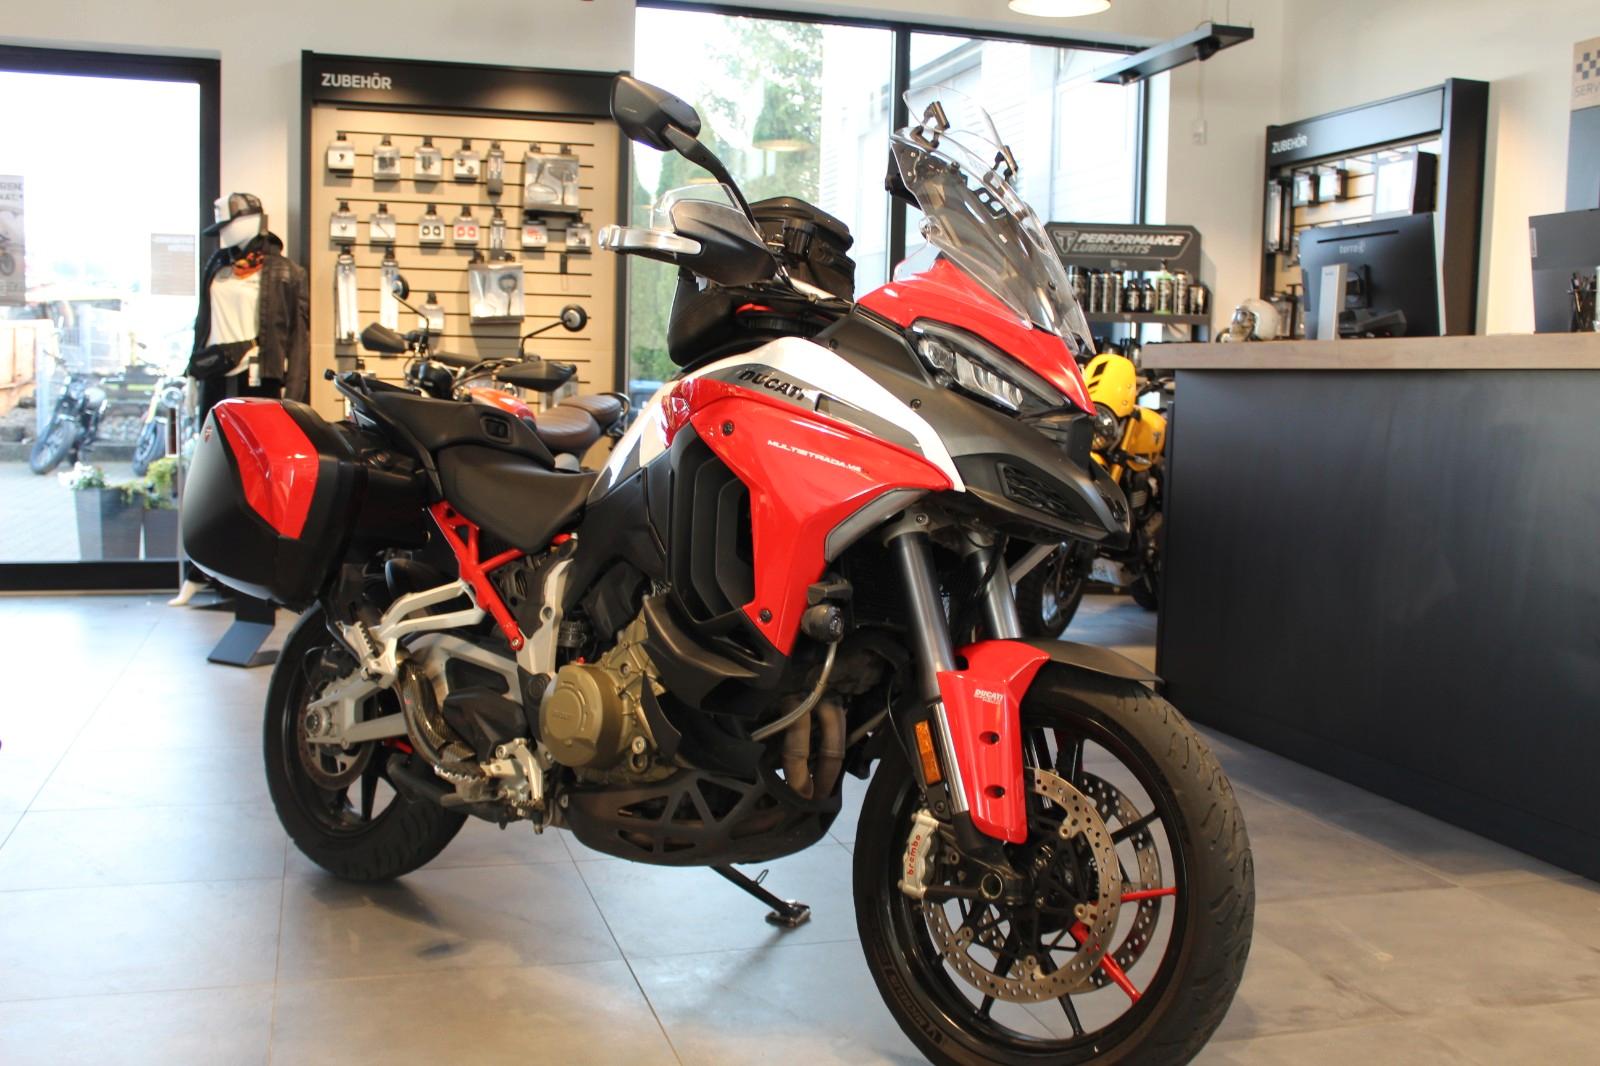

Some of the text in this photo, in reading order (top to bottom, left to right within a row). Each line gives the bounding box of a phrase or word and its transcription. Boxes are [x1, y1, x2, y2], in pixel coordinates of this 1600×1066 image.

[321, 72, 392, 90] ZUBEHÖR
[1271, 133, 1308, 154] ZUBEHÖR
[1072, 243, 1151, 255] LUBRICANTS
[1077, 233, 1185, 246] PERFORMANCE
[739, 370, 805, 401] DUCATI
[767, 439, 846, 469] MULTISTRADA
[973, 688, 1004, 701] DUCATI
[907, 834, 921, 876] brembo
